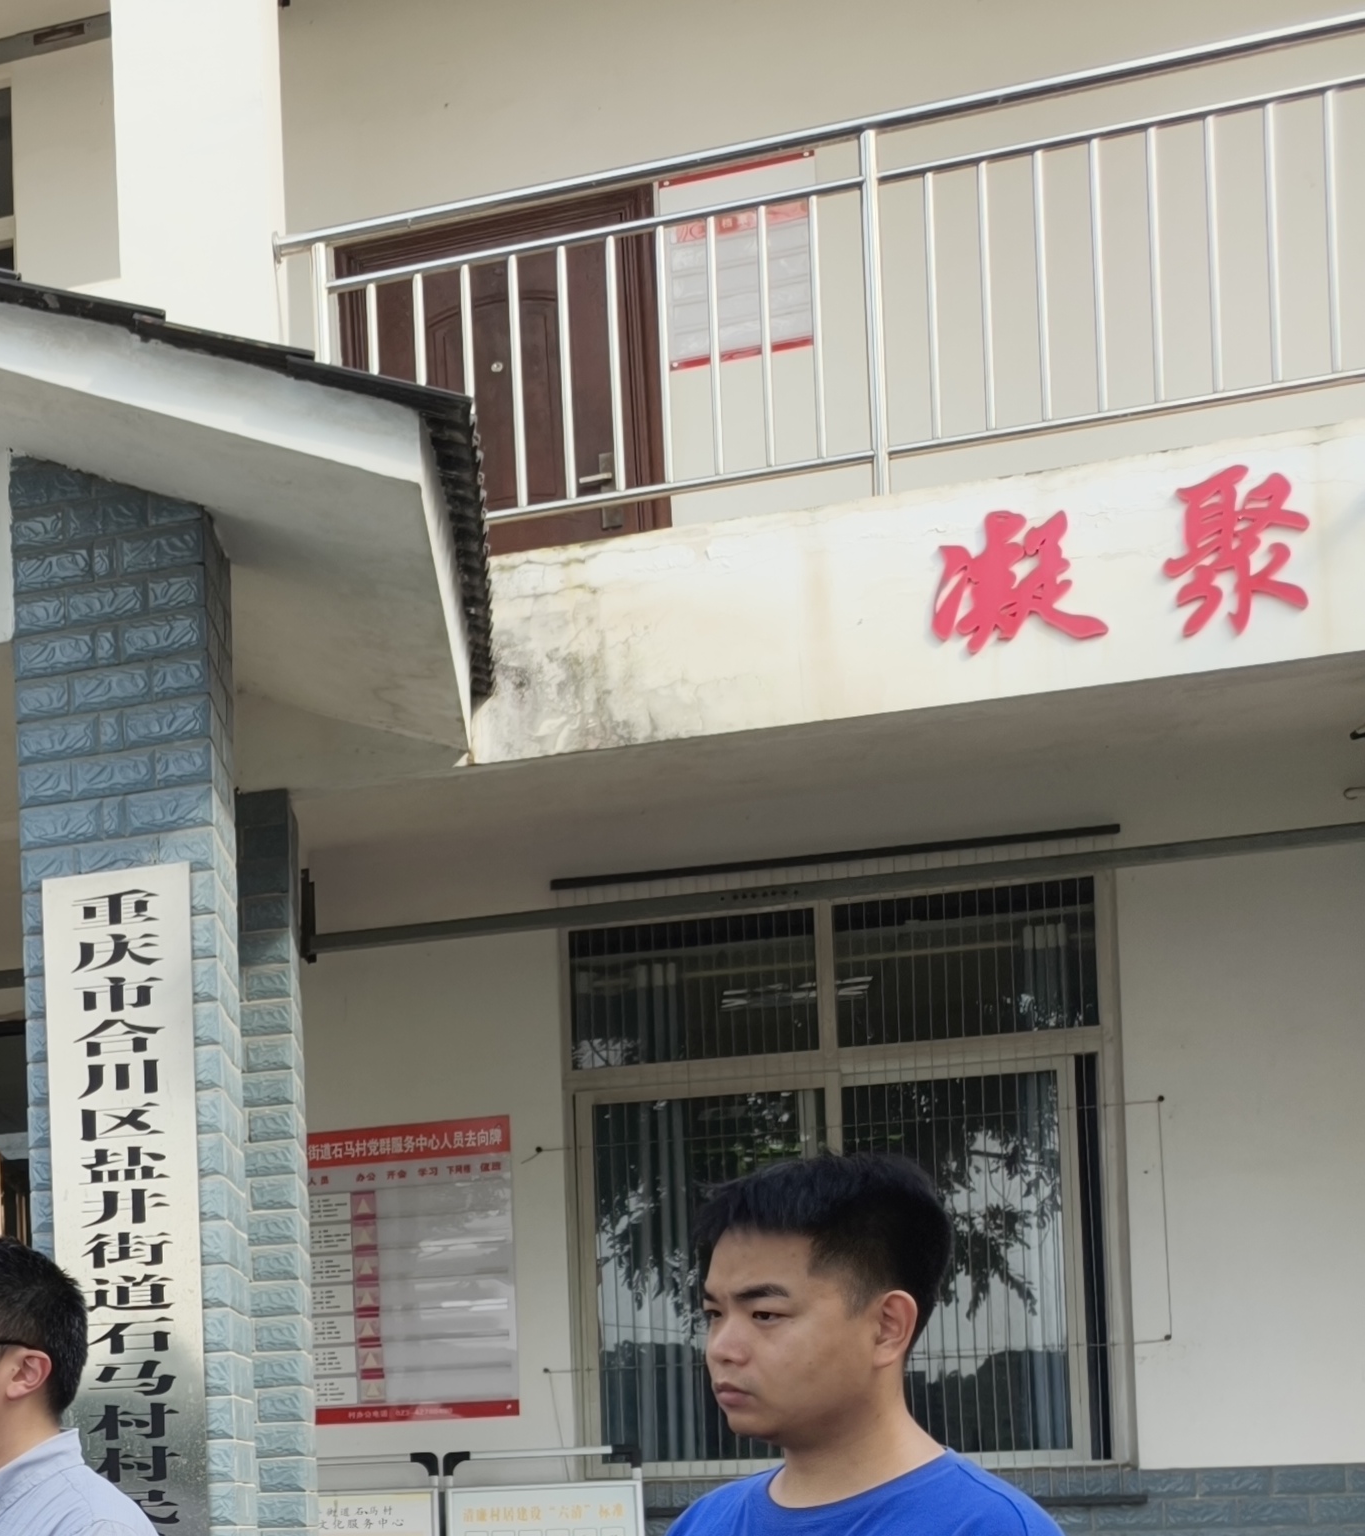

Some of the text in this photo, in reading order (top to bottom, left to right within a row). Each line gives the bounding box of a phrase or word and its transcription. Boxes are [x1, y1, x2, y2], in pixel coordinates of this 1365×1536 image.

[931, 464, 1309, 655] 凝聚
[356, 1172, 376, 1183] 办公
[386, 1169, 408, 1180] 开会
[417, 1166, 439, 1177] 学习
[320, 1505, 393, 1518] 街道石马村
